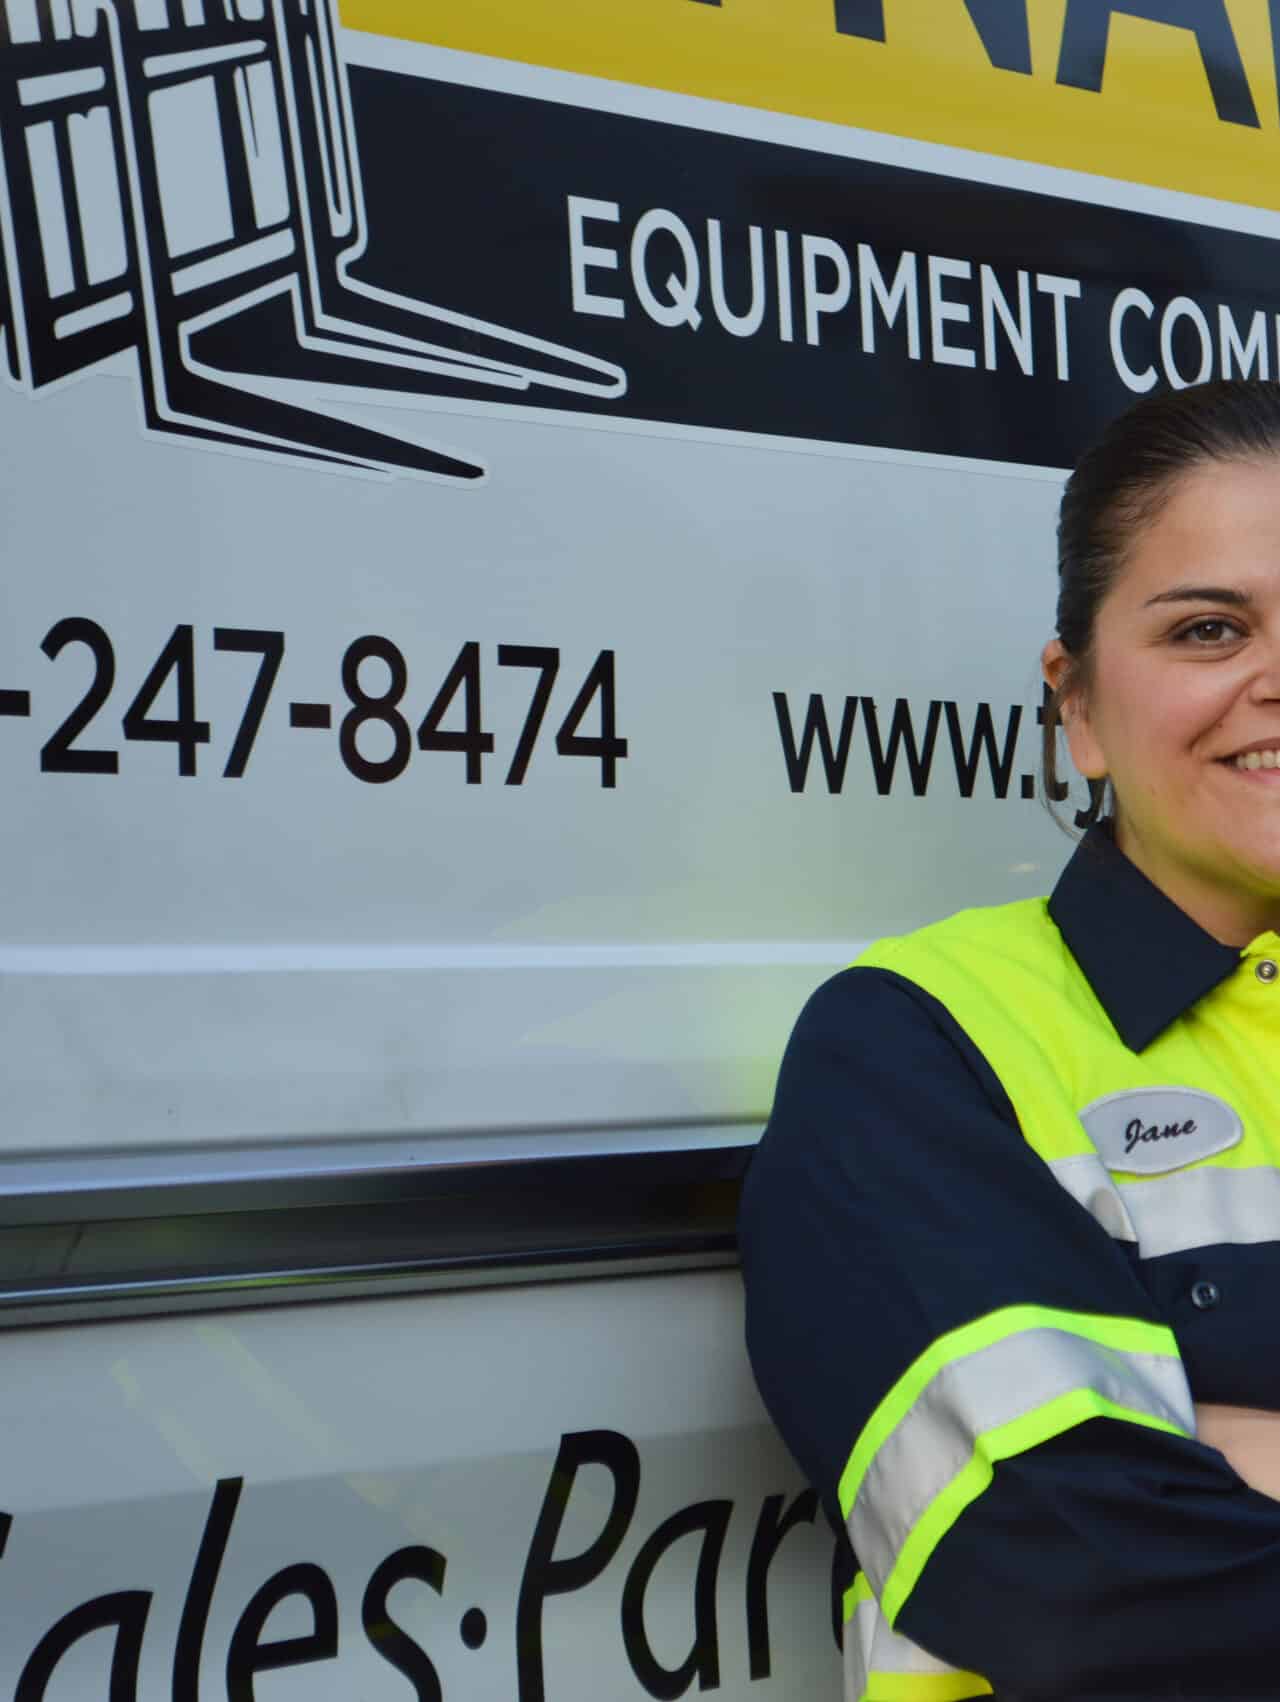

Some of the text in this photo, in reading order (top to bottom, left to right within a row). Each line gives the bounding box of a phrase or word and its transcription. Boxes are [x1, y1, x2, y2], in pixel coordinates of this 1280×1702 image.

[567, 195, 1081, 382] EQUIPMENT
[1124, 1117, 1197, 1154] Jane
[0, 1429, 844, 1702] ales Par
